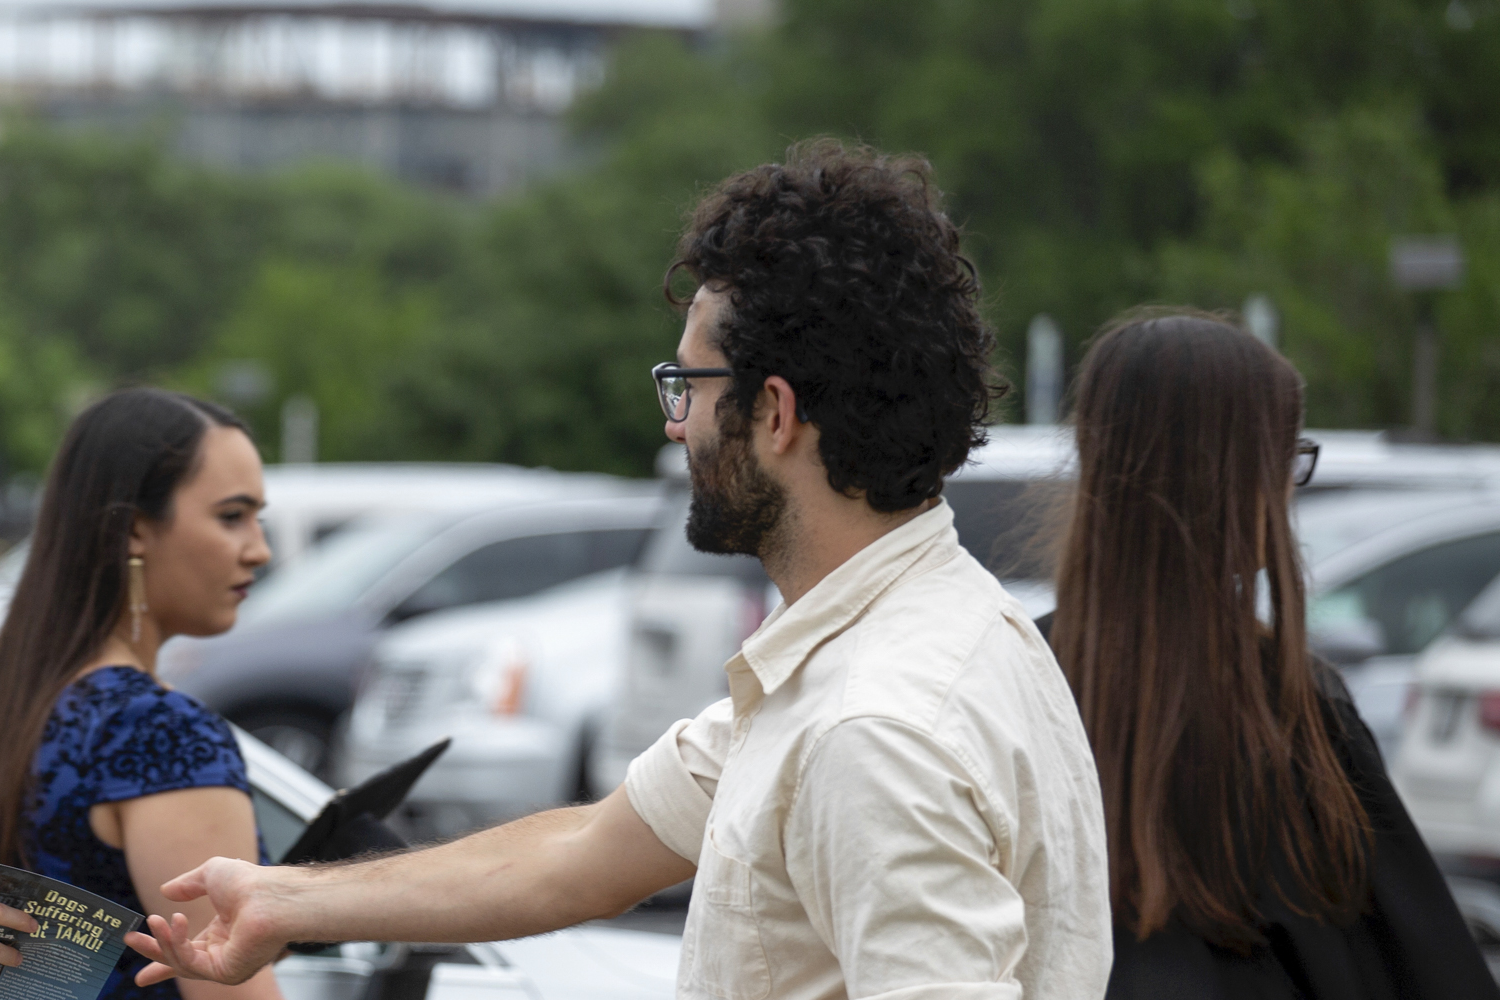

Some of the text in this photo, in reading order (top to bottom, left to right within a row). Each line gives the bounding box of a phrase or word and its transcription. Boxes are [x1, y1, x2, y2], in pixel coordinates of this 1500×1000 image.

[24, 900, 103, 938] Suffering
[45, 890, 88, 913] Dogs
[92, 908, 122, 929] Are
[55, 922, 104, 953] TAMU!
